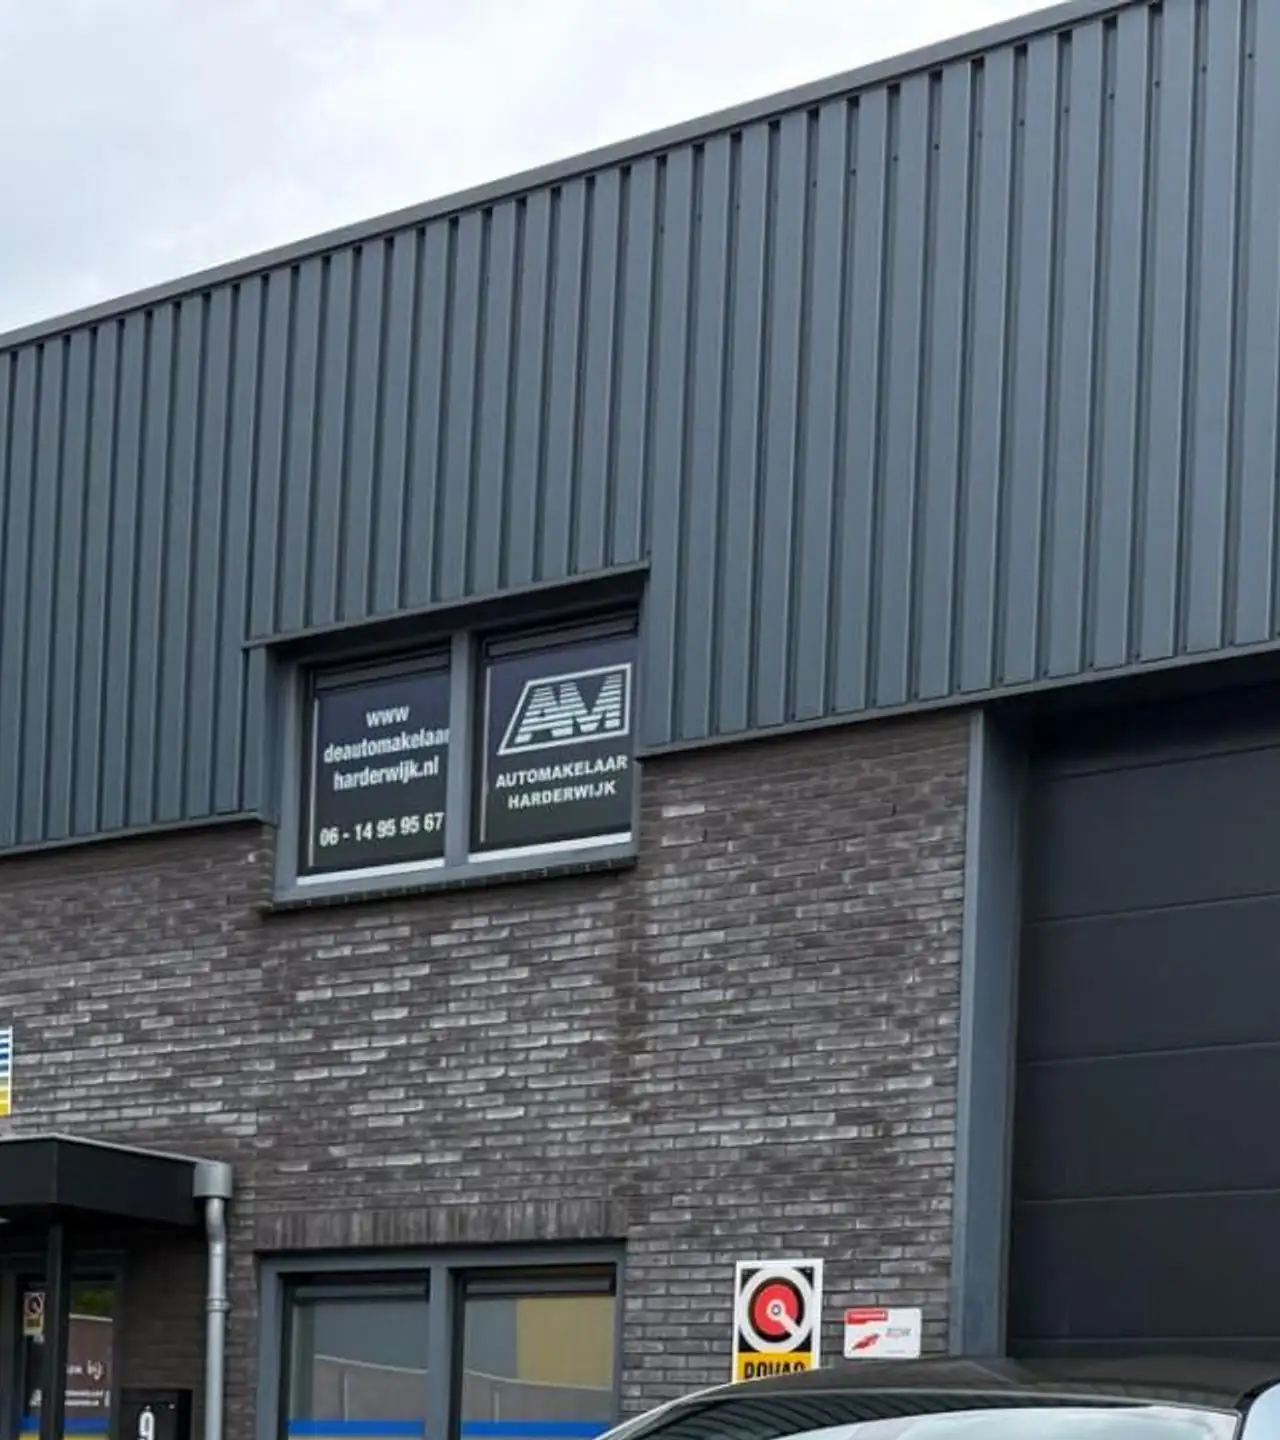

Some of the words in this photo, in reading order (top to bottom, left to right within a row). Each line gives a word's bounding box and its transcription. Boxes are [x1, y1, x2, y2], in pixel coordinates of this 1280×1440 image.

[366, 706, 410, 728] www
[324, 728, 451, 763] deautomakelaar
[333, 755, 439, 791] harderwijk.nl
[496, 755, 629, 788] AUTOMAKELAAR
[508, 780, 617, 810] HARDERWIJK
[320, 827, 339, 847] 06
[355, 822, 373, 842] 14
